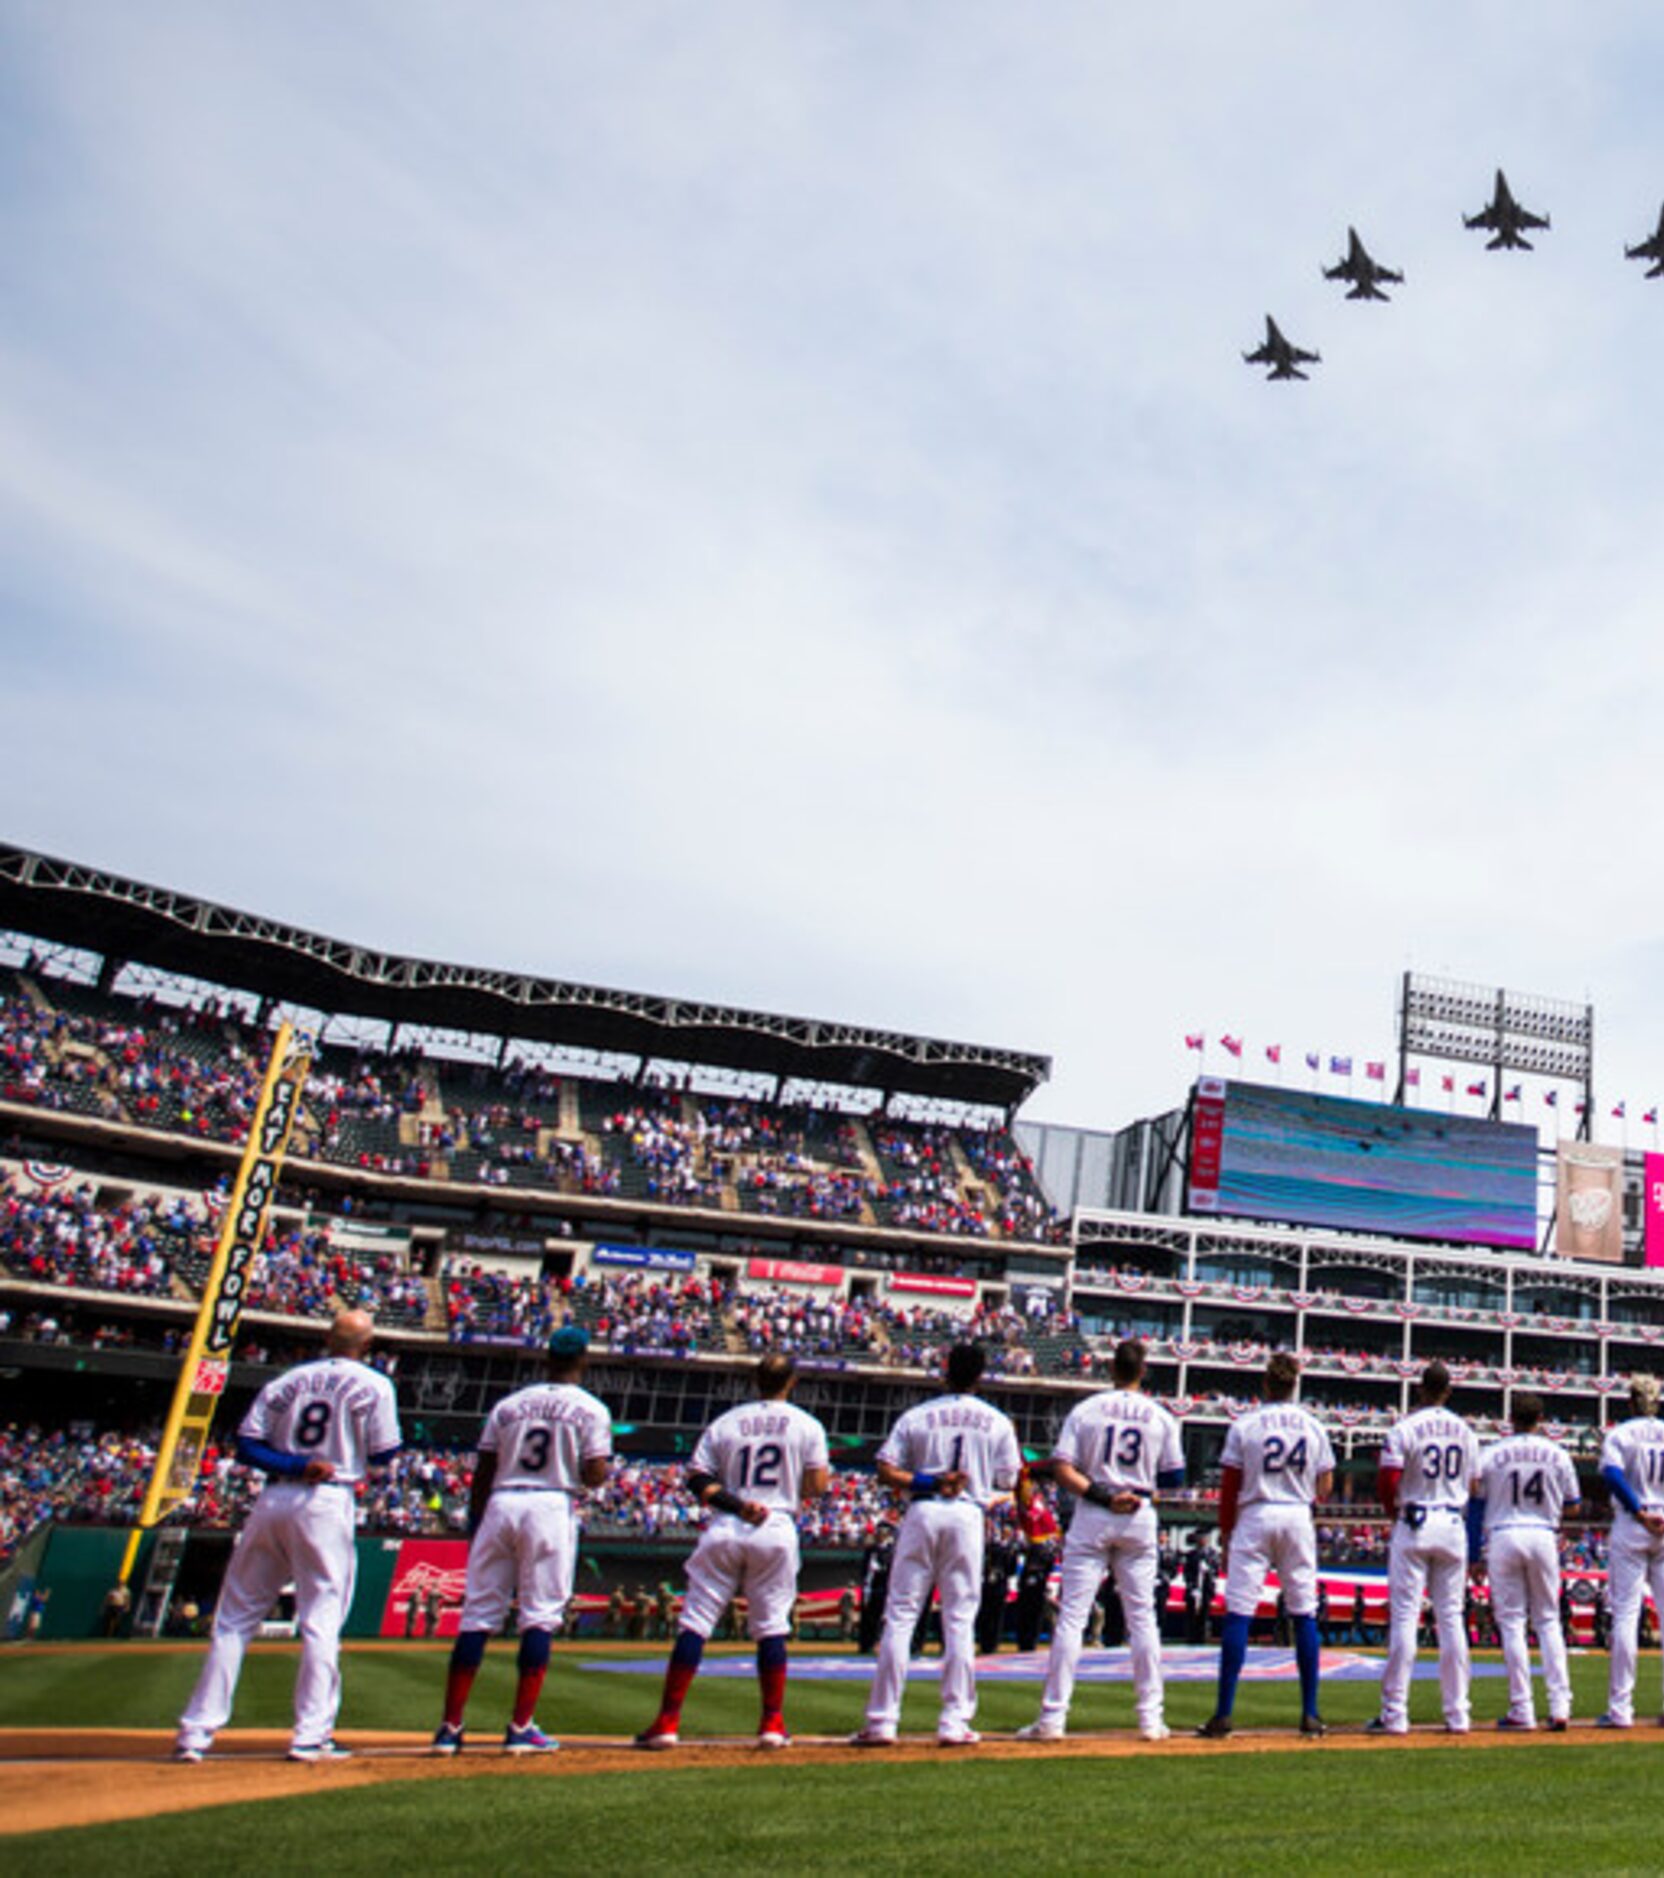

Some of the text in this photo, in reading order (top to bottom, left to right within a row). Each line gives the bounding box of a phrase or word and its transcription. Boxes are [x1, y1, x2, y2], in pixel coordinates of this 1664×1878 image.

[211, 1082, 294, 1347] EAT MOR FOWL
[296, 1400, 331, 1448] 8
[1102, 1423, 1143, 1467] 13
[519, 1427, 551, 1473] 3
[736, 1442, 783, 1488] 12
[950, 1433, 964, 1472] 1
[1263, 1434, 1308, 1474] 24
[1422, 1443, 1464, 1481] 30
[1508, 1469, 1545, 1507] 14
